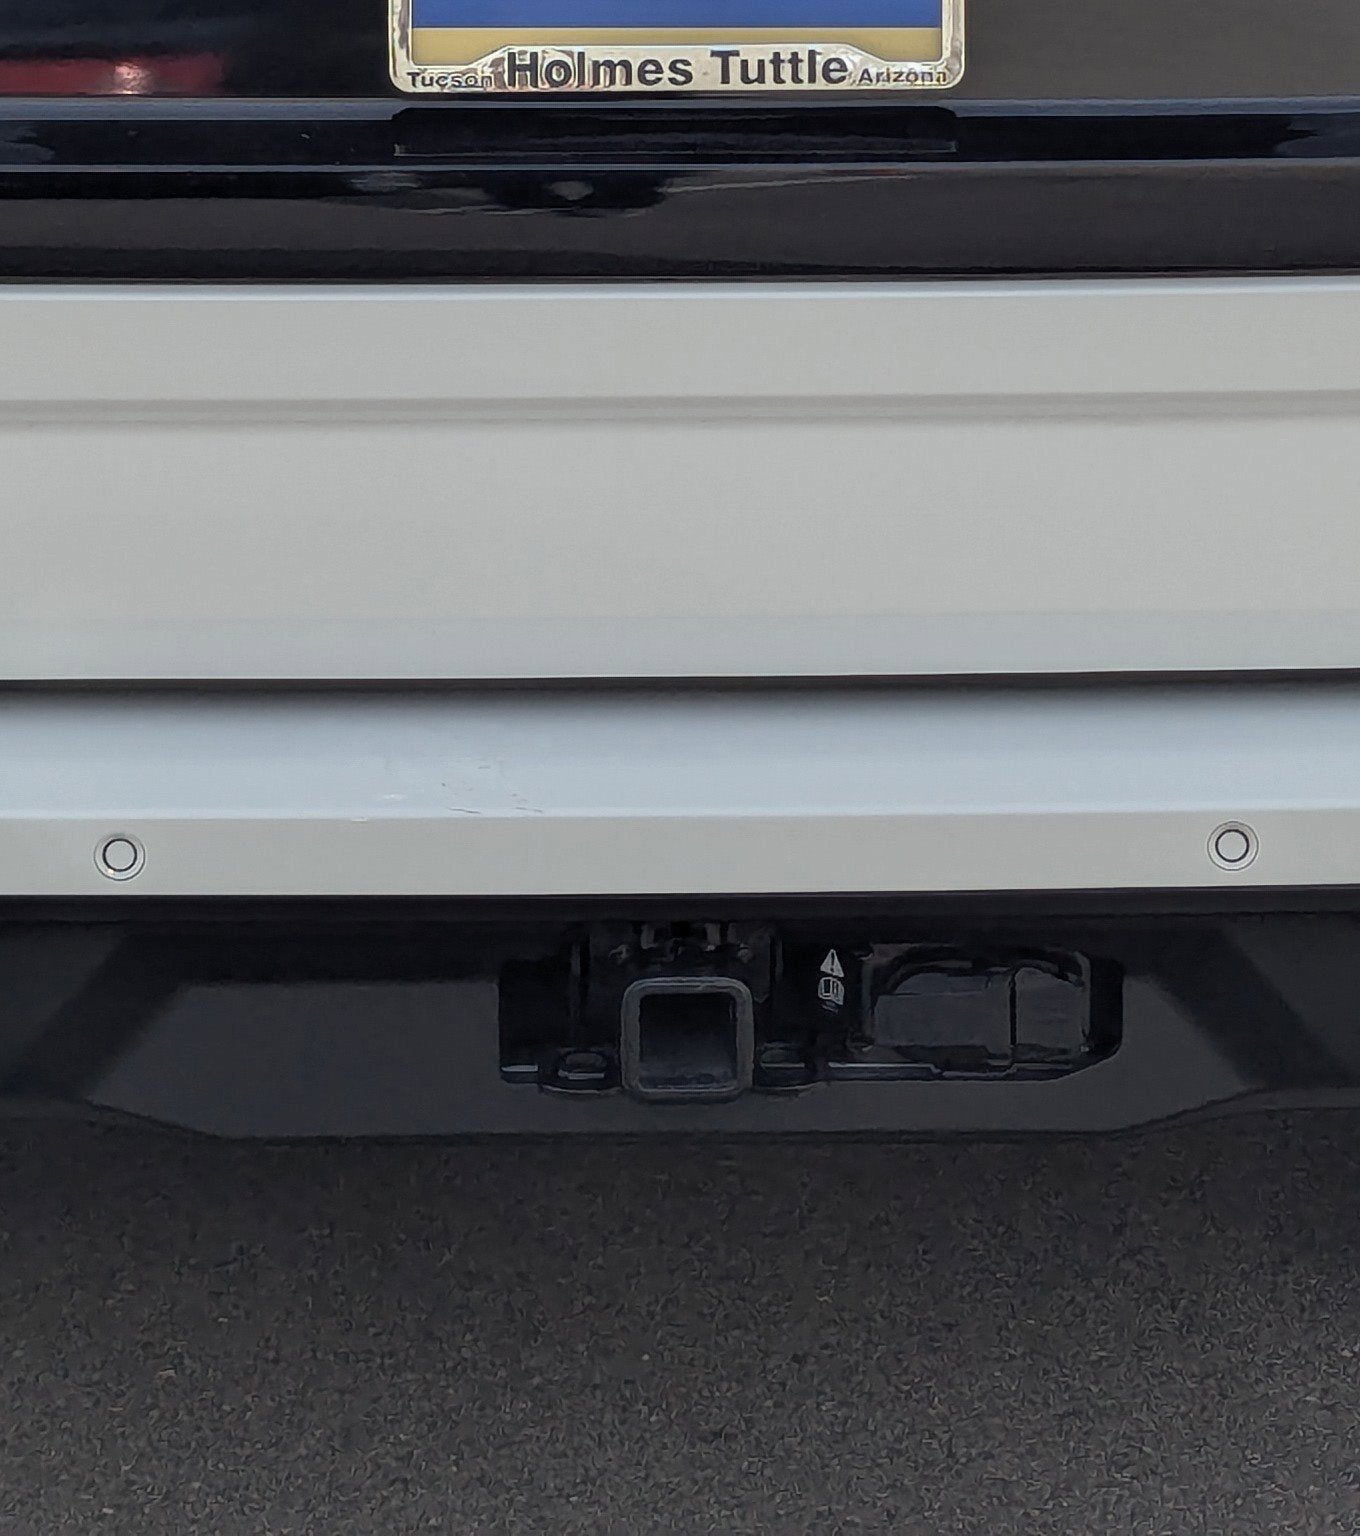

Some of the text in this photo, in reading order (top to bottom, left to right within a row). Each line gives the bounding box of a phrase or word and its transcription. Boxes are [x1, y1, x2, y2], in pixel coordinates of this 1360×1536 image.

[506, 49, 849, 88] Holmes Tuttle
[857, 66, 948, 85] Arizona
[407, 71, 492, 89] Tucson
